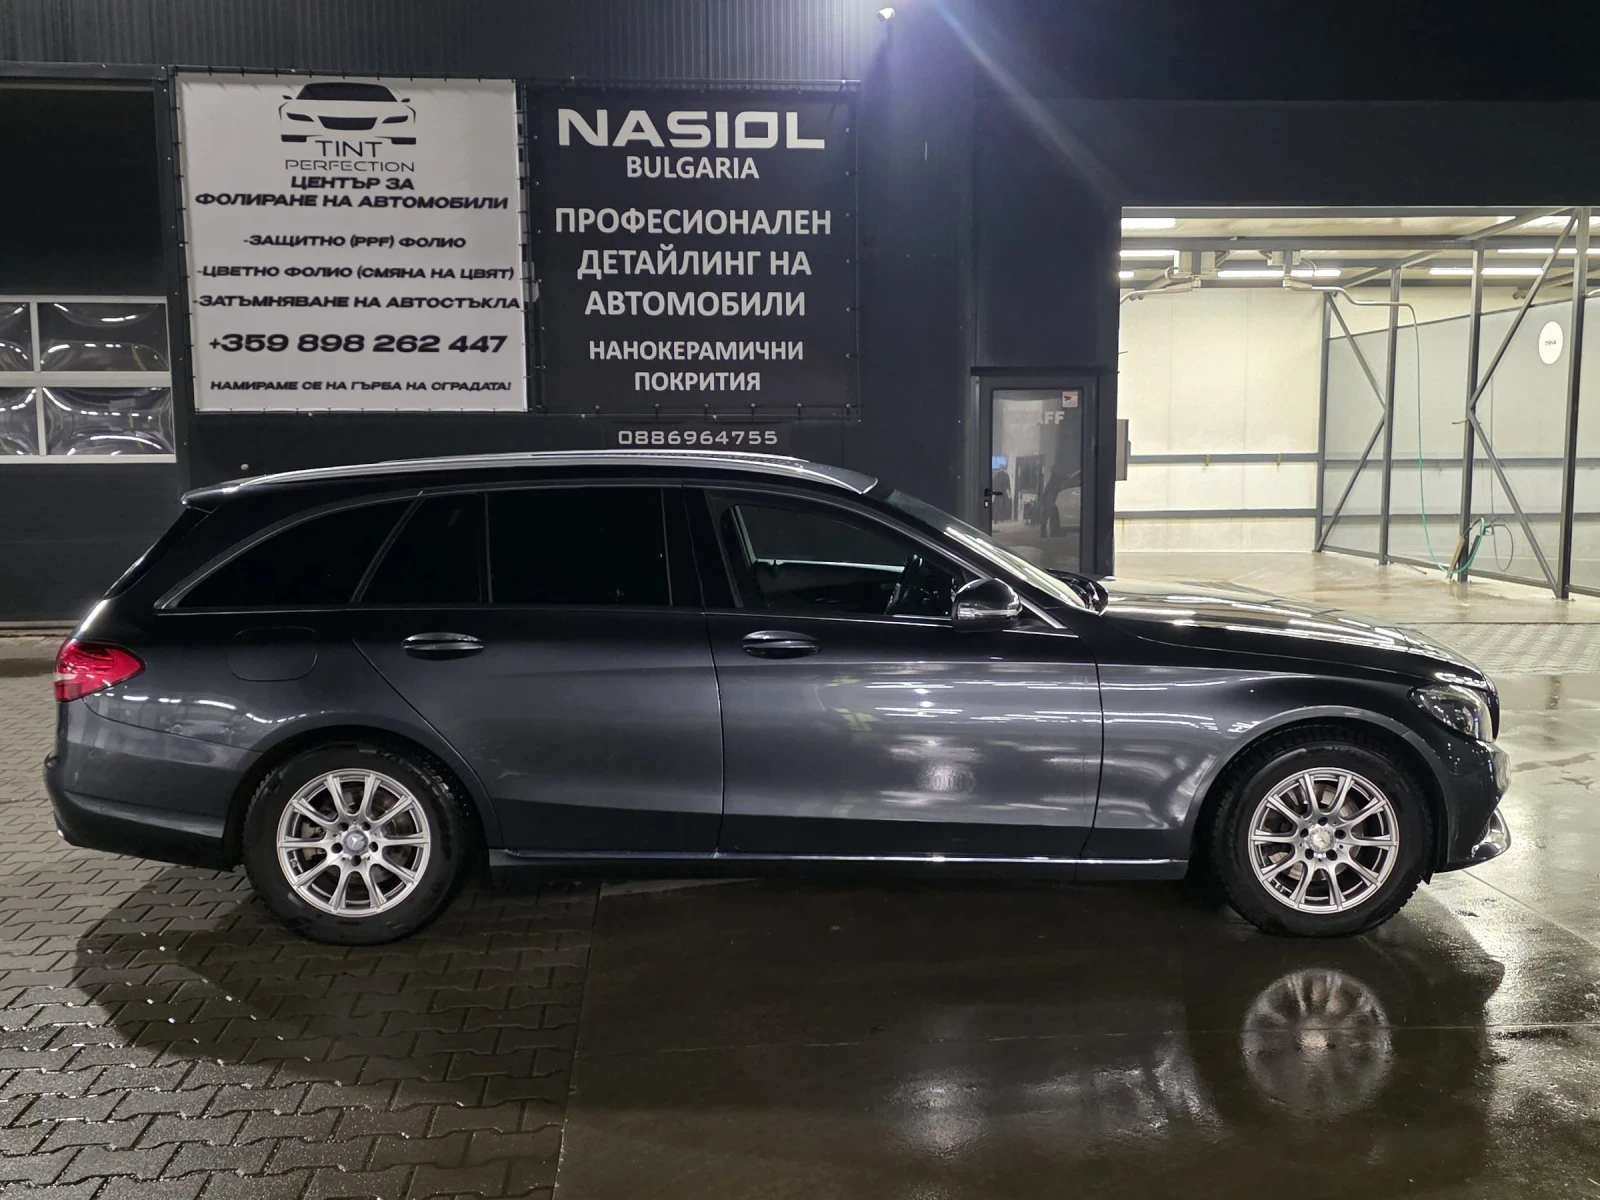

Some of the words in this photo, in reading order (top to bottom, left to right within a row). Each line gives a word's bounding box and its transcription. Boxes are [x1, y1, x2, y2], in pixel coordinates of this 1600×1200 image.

[558, 109, 825, 149] NASIOL
[315, 140, 382, 157] TINT
[285, 159, 415, 173] PERFECTION
[627, 156, 759, 179] BULGARIA
[290, 175, 381, 191] ЦЕНТЪР
[385, 177, 415, 191] ЗА
[194, 192, 319, 207] ФОЛИРАНЕ
[322, 194, 353, 208] НА
[357, 195, 509, 210] АВТОМОБИЛИ
[556, 208, 831, 234] ПРОФЕСИОНАЛЕН
[398, 237, 467, 249] ФОЛИО
[578, 244, 761, 280] ДЕТАЙЛИНГ
[771, 251, 811, 275] НА
[283, 266, 353, 278] ФОЛИО
[430, 267, 456, 279] НА
[459, 266, 515, 281] ЦВЯТ)
[353, 296, 382, 308] НА
[385, 296, 521, 309] АВТОСТЪКЛА
[585, 291, 805, 316] АВТОМОБИЛИ
[298, 334, 364, 352] 898
[373, 335, 440, 352] 262
[448, 336, 507, 352] 447
[590, 341, 803, 360] НАНОКЕРАМИЧНИ
[210, 380, 299, 391] НАМИРАМЕ
[301, 380, 323, 391] СЕ
[325, 381, 348, 391] НА
[350, 381, 403, 391] ГЪРБА
[405, 381, 428, 391] НА
[430, 381, 512, 392] СГРАДАТА!
[635, 372, 760, 391] ПОКРИТИЯ
[618, 430, 778, 445] 0886964755
